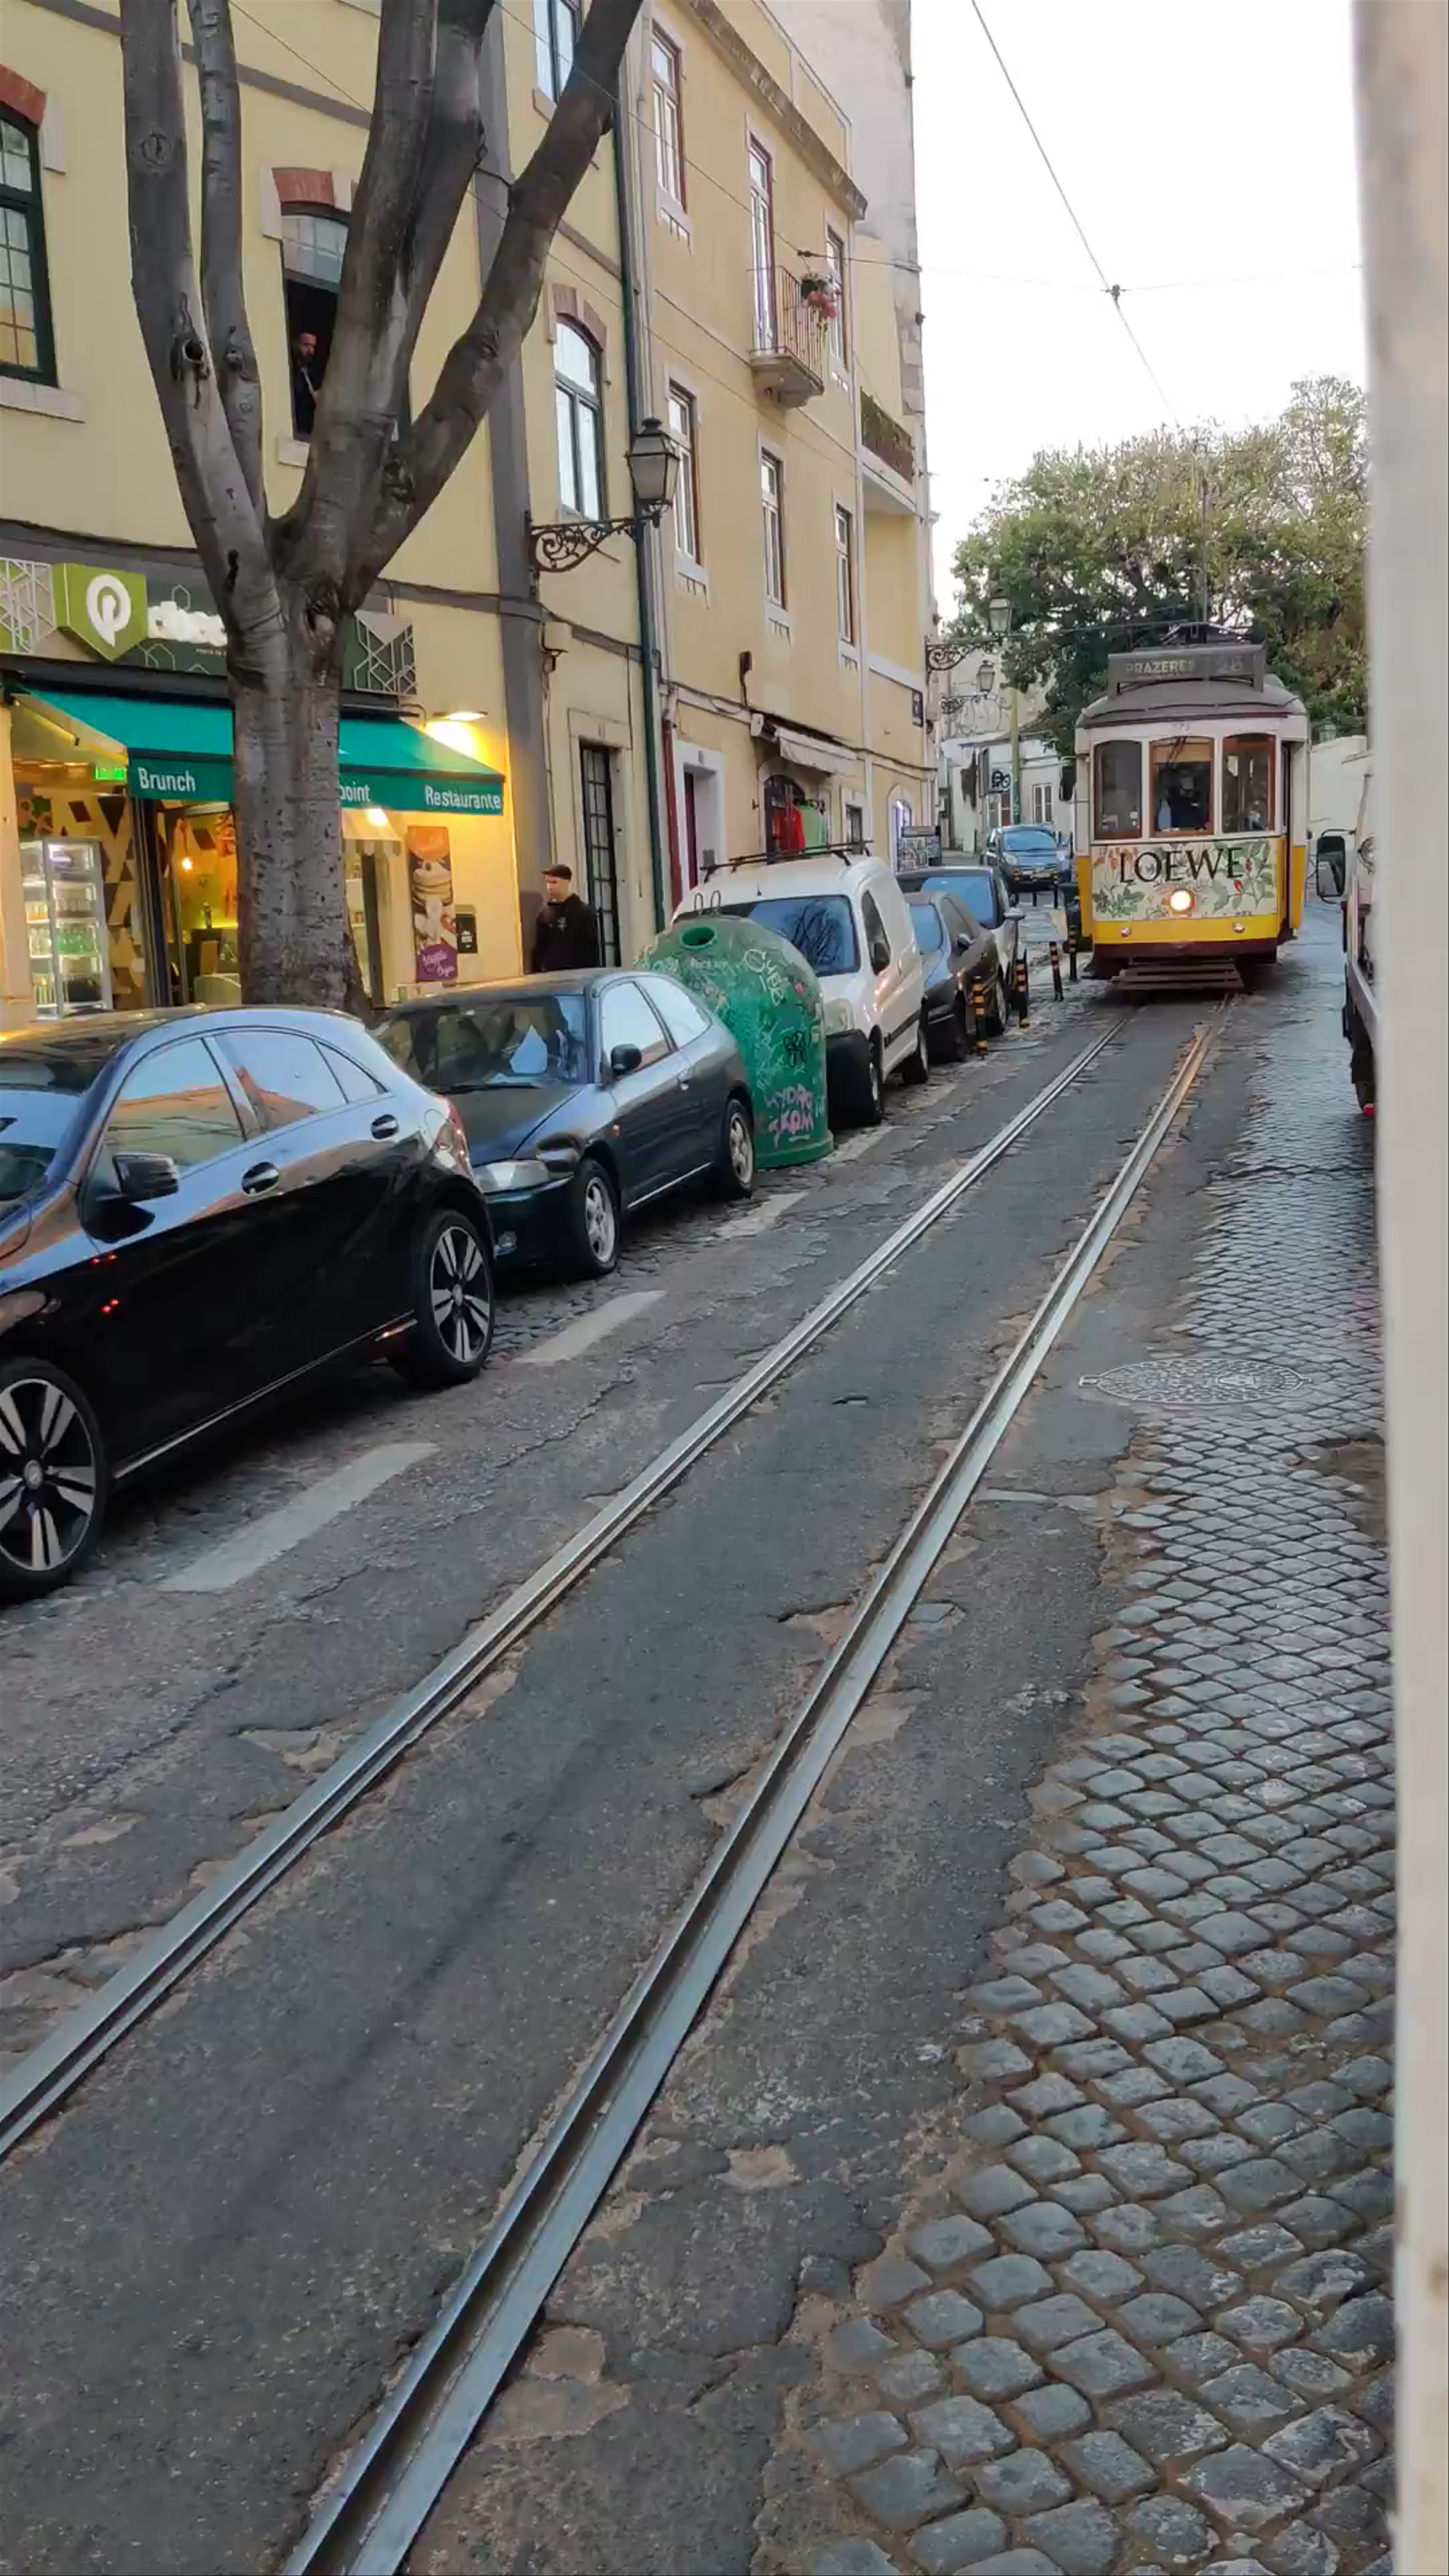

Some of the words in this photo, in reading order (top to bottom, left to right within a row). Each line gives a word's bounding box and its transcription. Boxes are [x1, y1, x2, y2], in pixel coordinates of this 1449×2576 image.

[137, 767, 196, 792] Brunch
[425, 785, 501, 809] Restaurante
[1120, 847, 1243, 883] LOEWE
